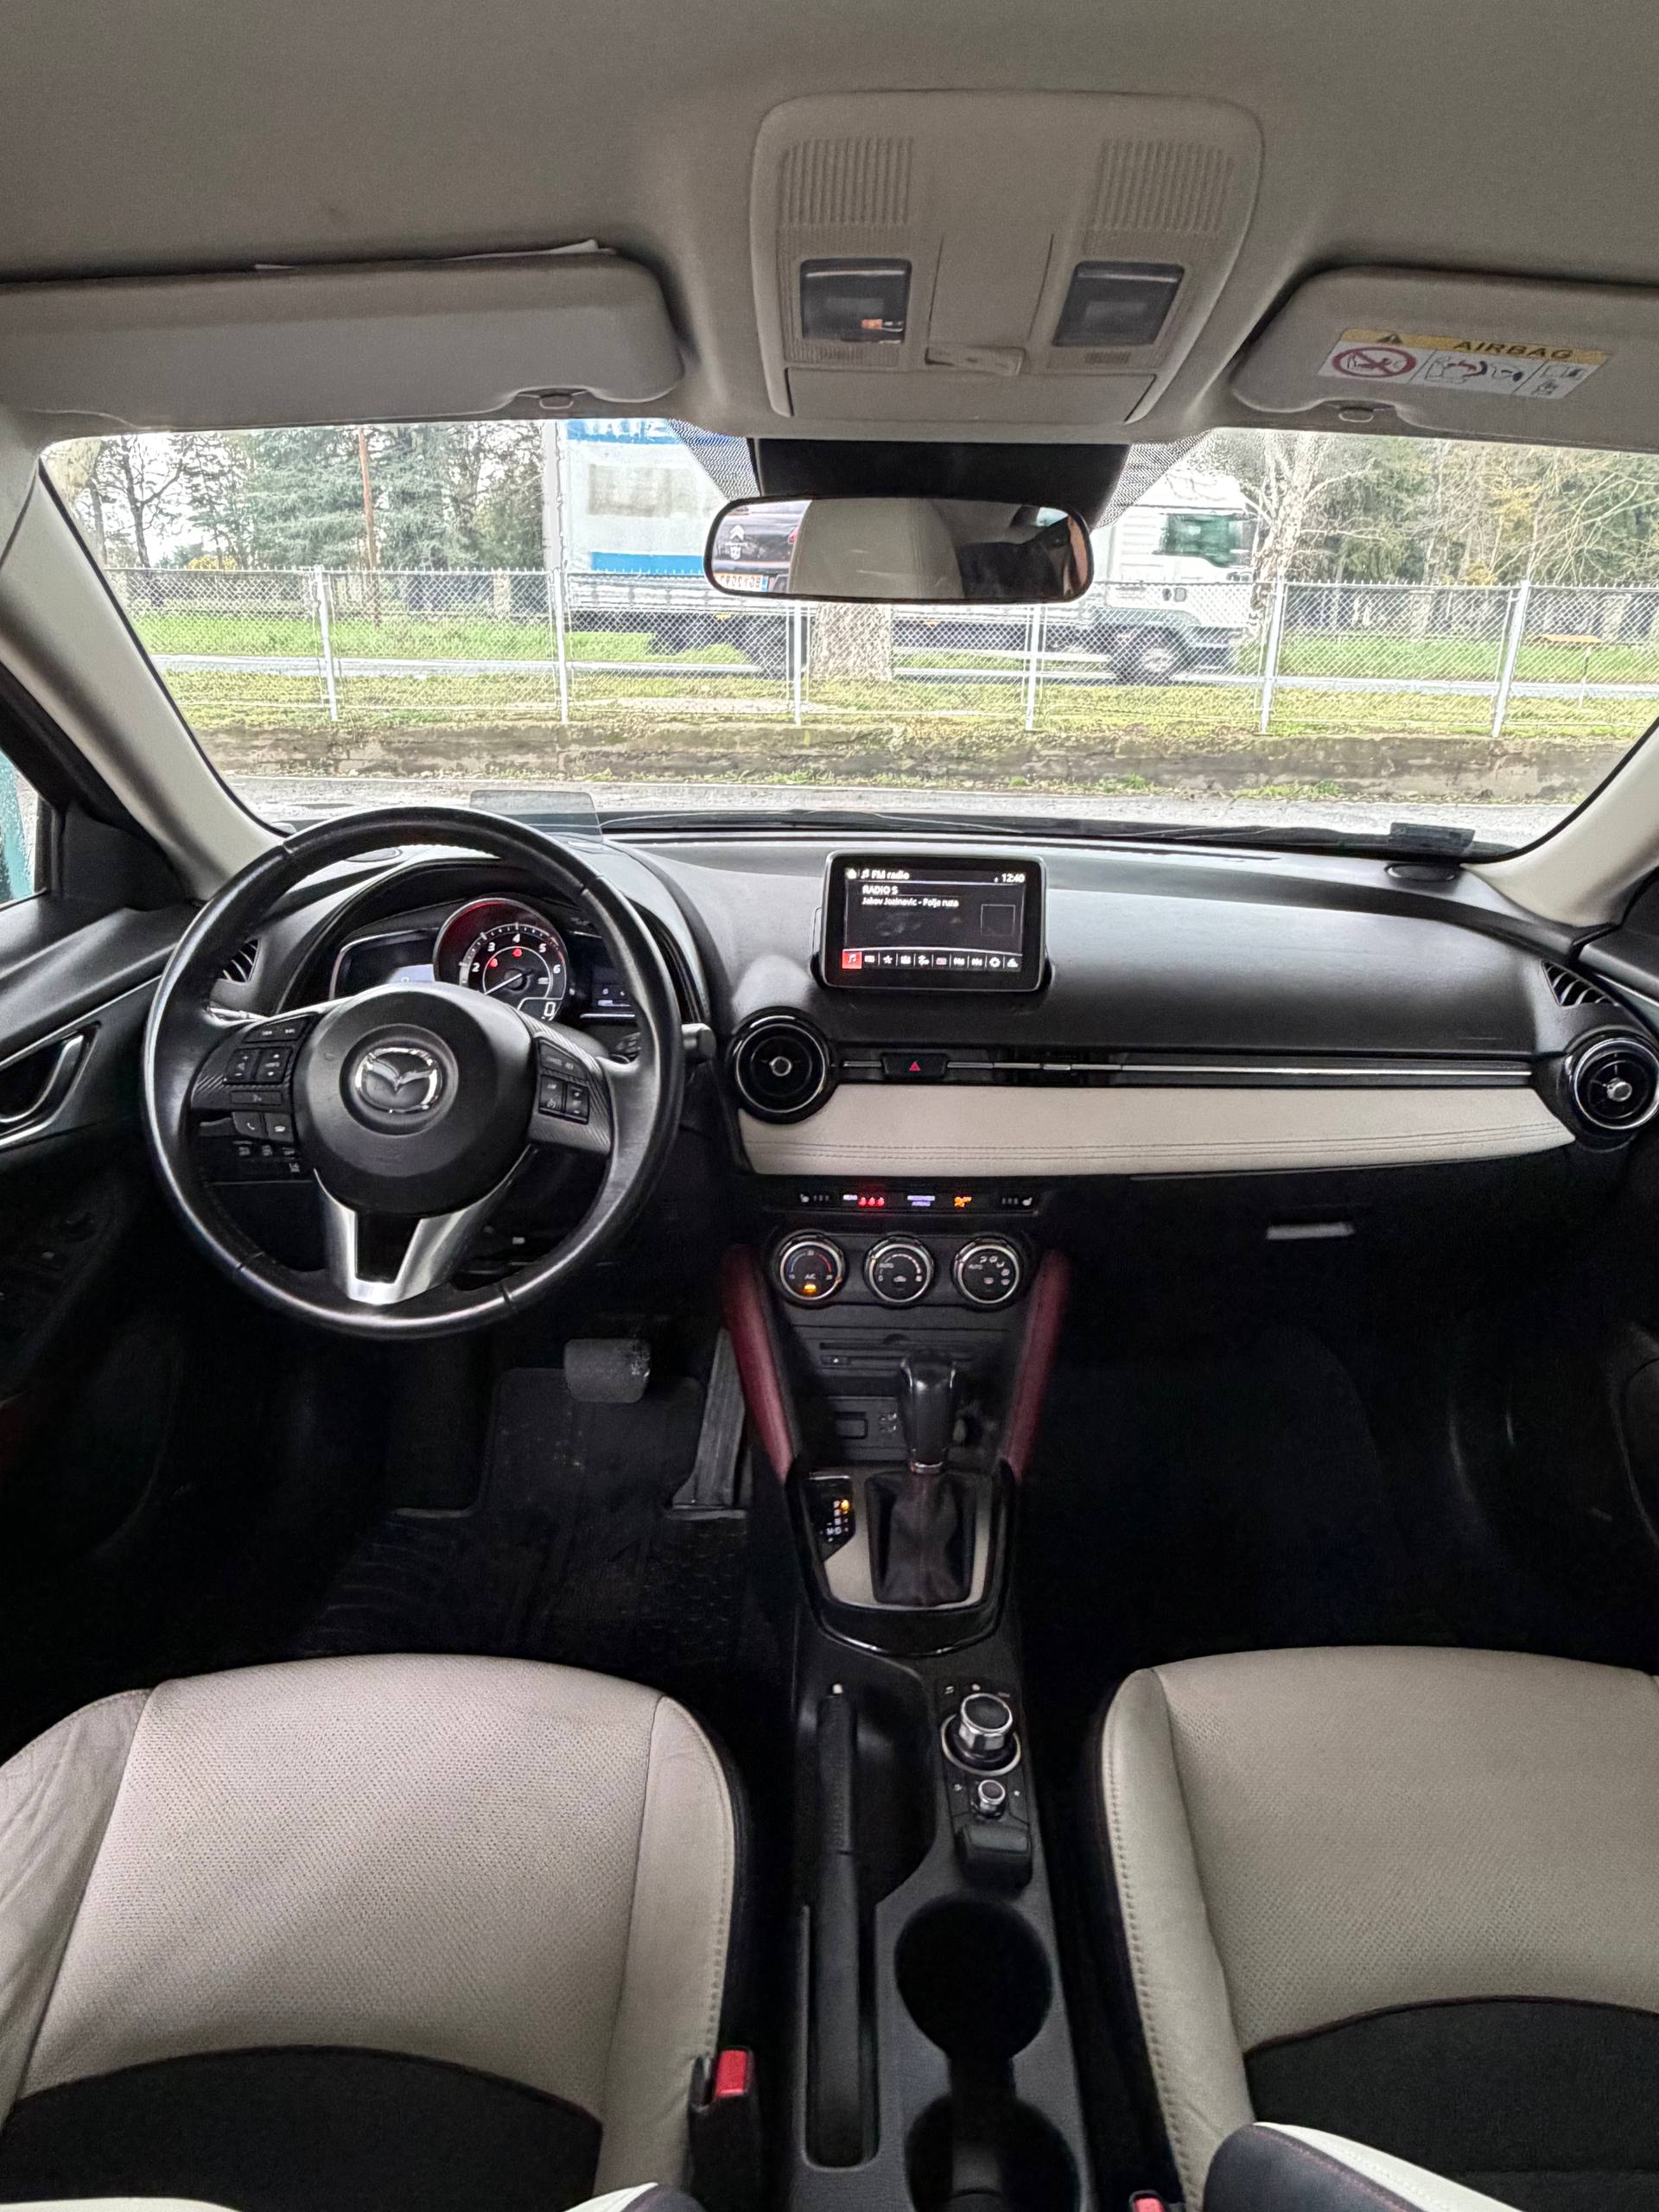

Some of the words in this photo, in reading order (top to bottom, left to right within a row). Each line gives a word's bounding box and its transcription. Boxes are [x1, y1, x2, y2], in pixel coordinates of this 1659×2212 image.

[1452, 340, 1573, 359] AIRBAG
[871, 869, 886, 880] FM
[887, 870, 910, 880] radio
[1001, 873, 1026, 883] 12:40
[862, 885, 891, 895] RADIO
[512, 933, 521, 944] 4
[487, 942, 496, 952] 3
[538, 943, 547, 953] 5
[472, 963, 480, 973] 2
[553, 964, 561, 975] 6
